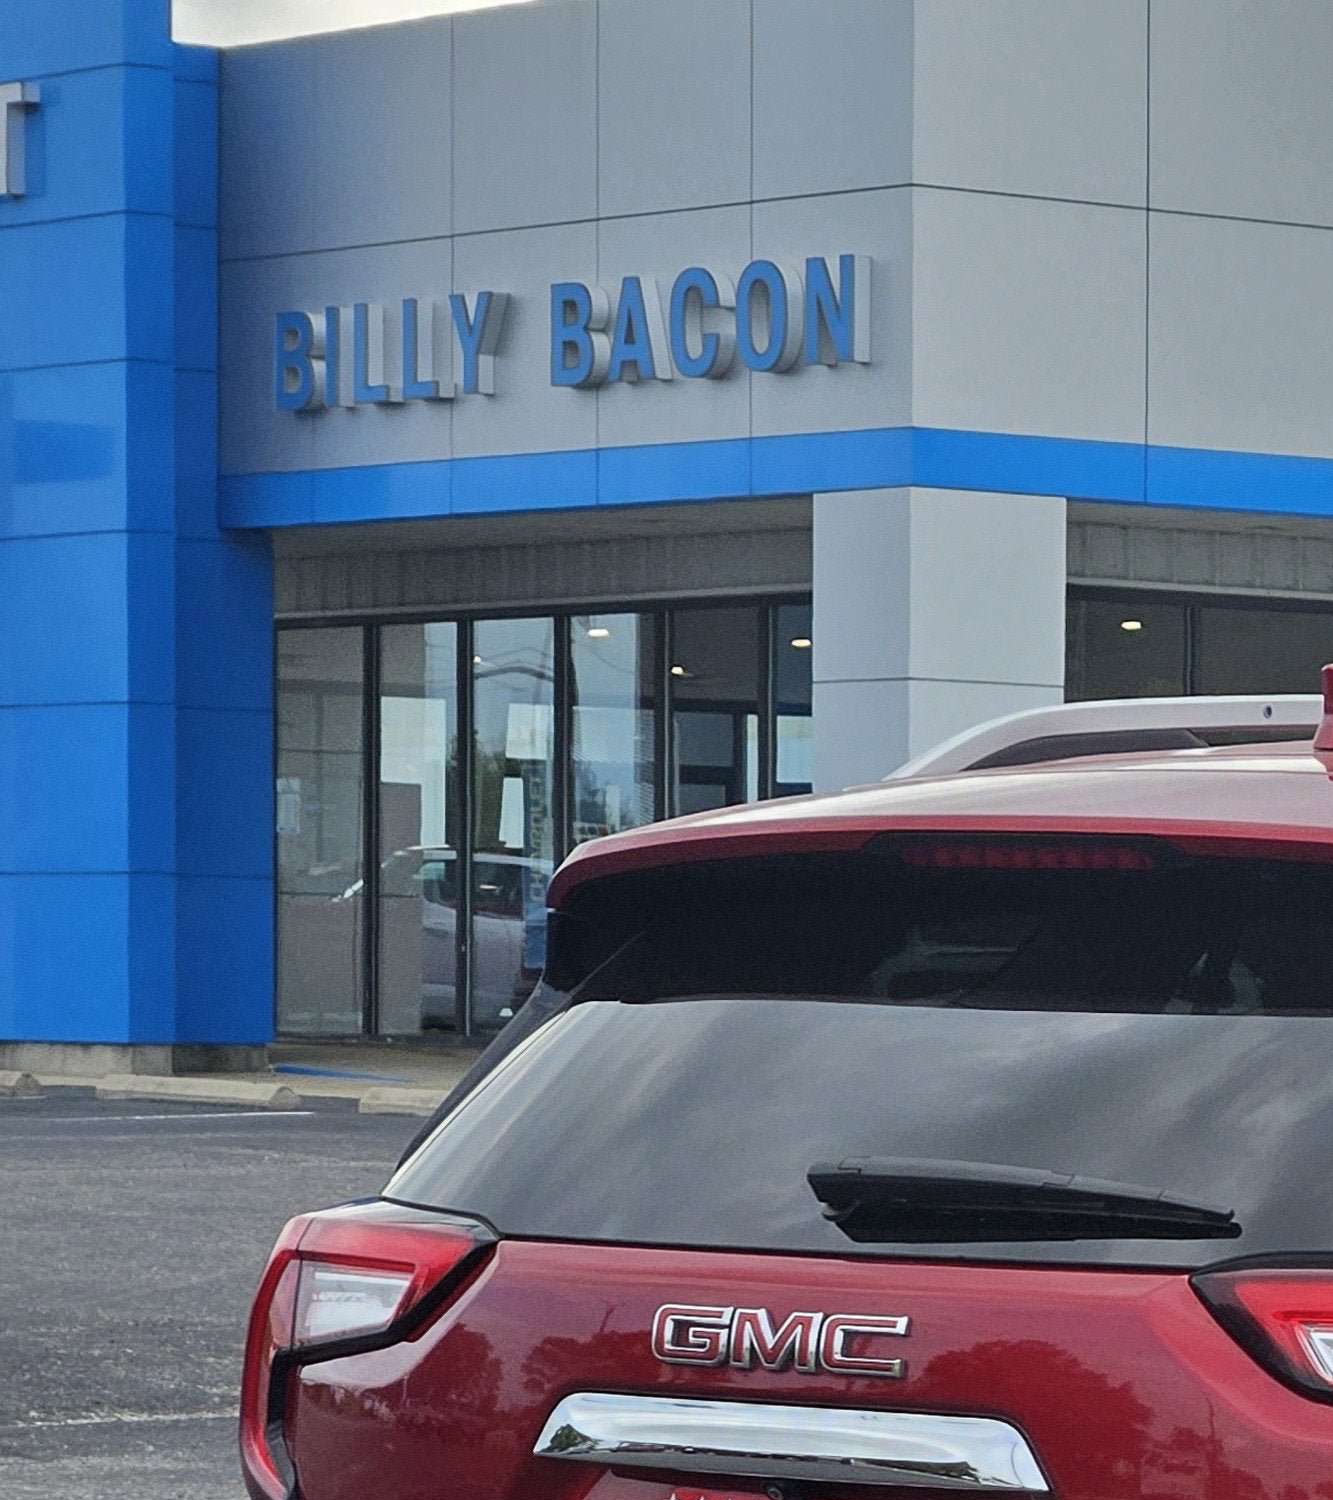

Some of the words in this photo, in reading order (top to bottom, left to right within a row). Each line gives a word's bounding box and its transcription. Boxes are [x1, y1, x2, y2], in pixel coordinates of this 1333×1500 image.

[276, 291, 512, 408] BILLY
[551, 254, 871, 388] BACON
[651, 1303, 910, 1378] GMC
